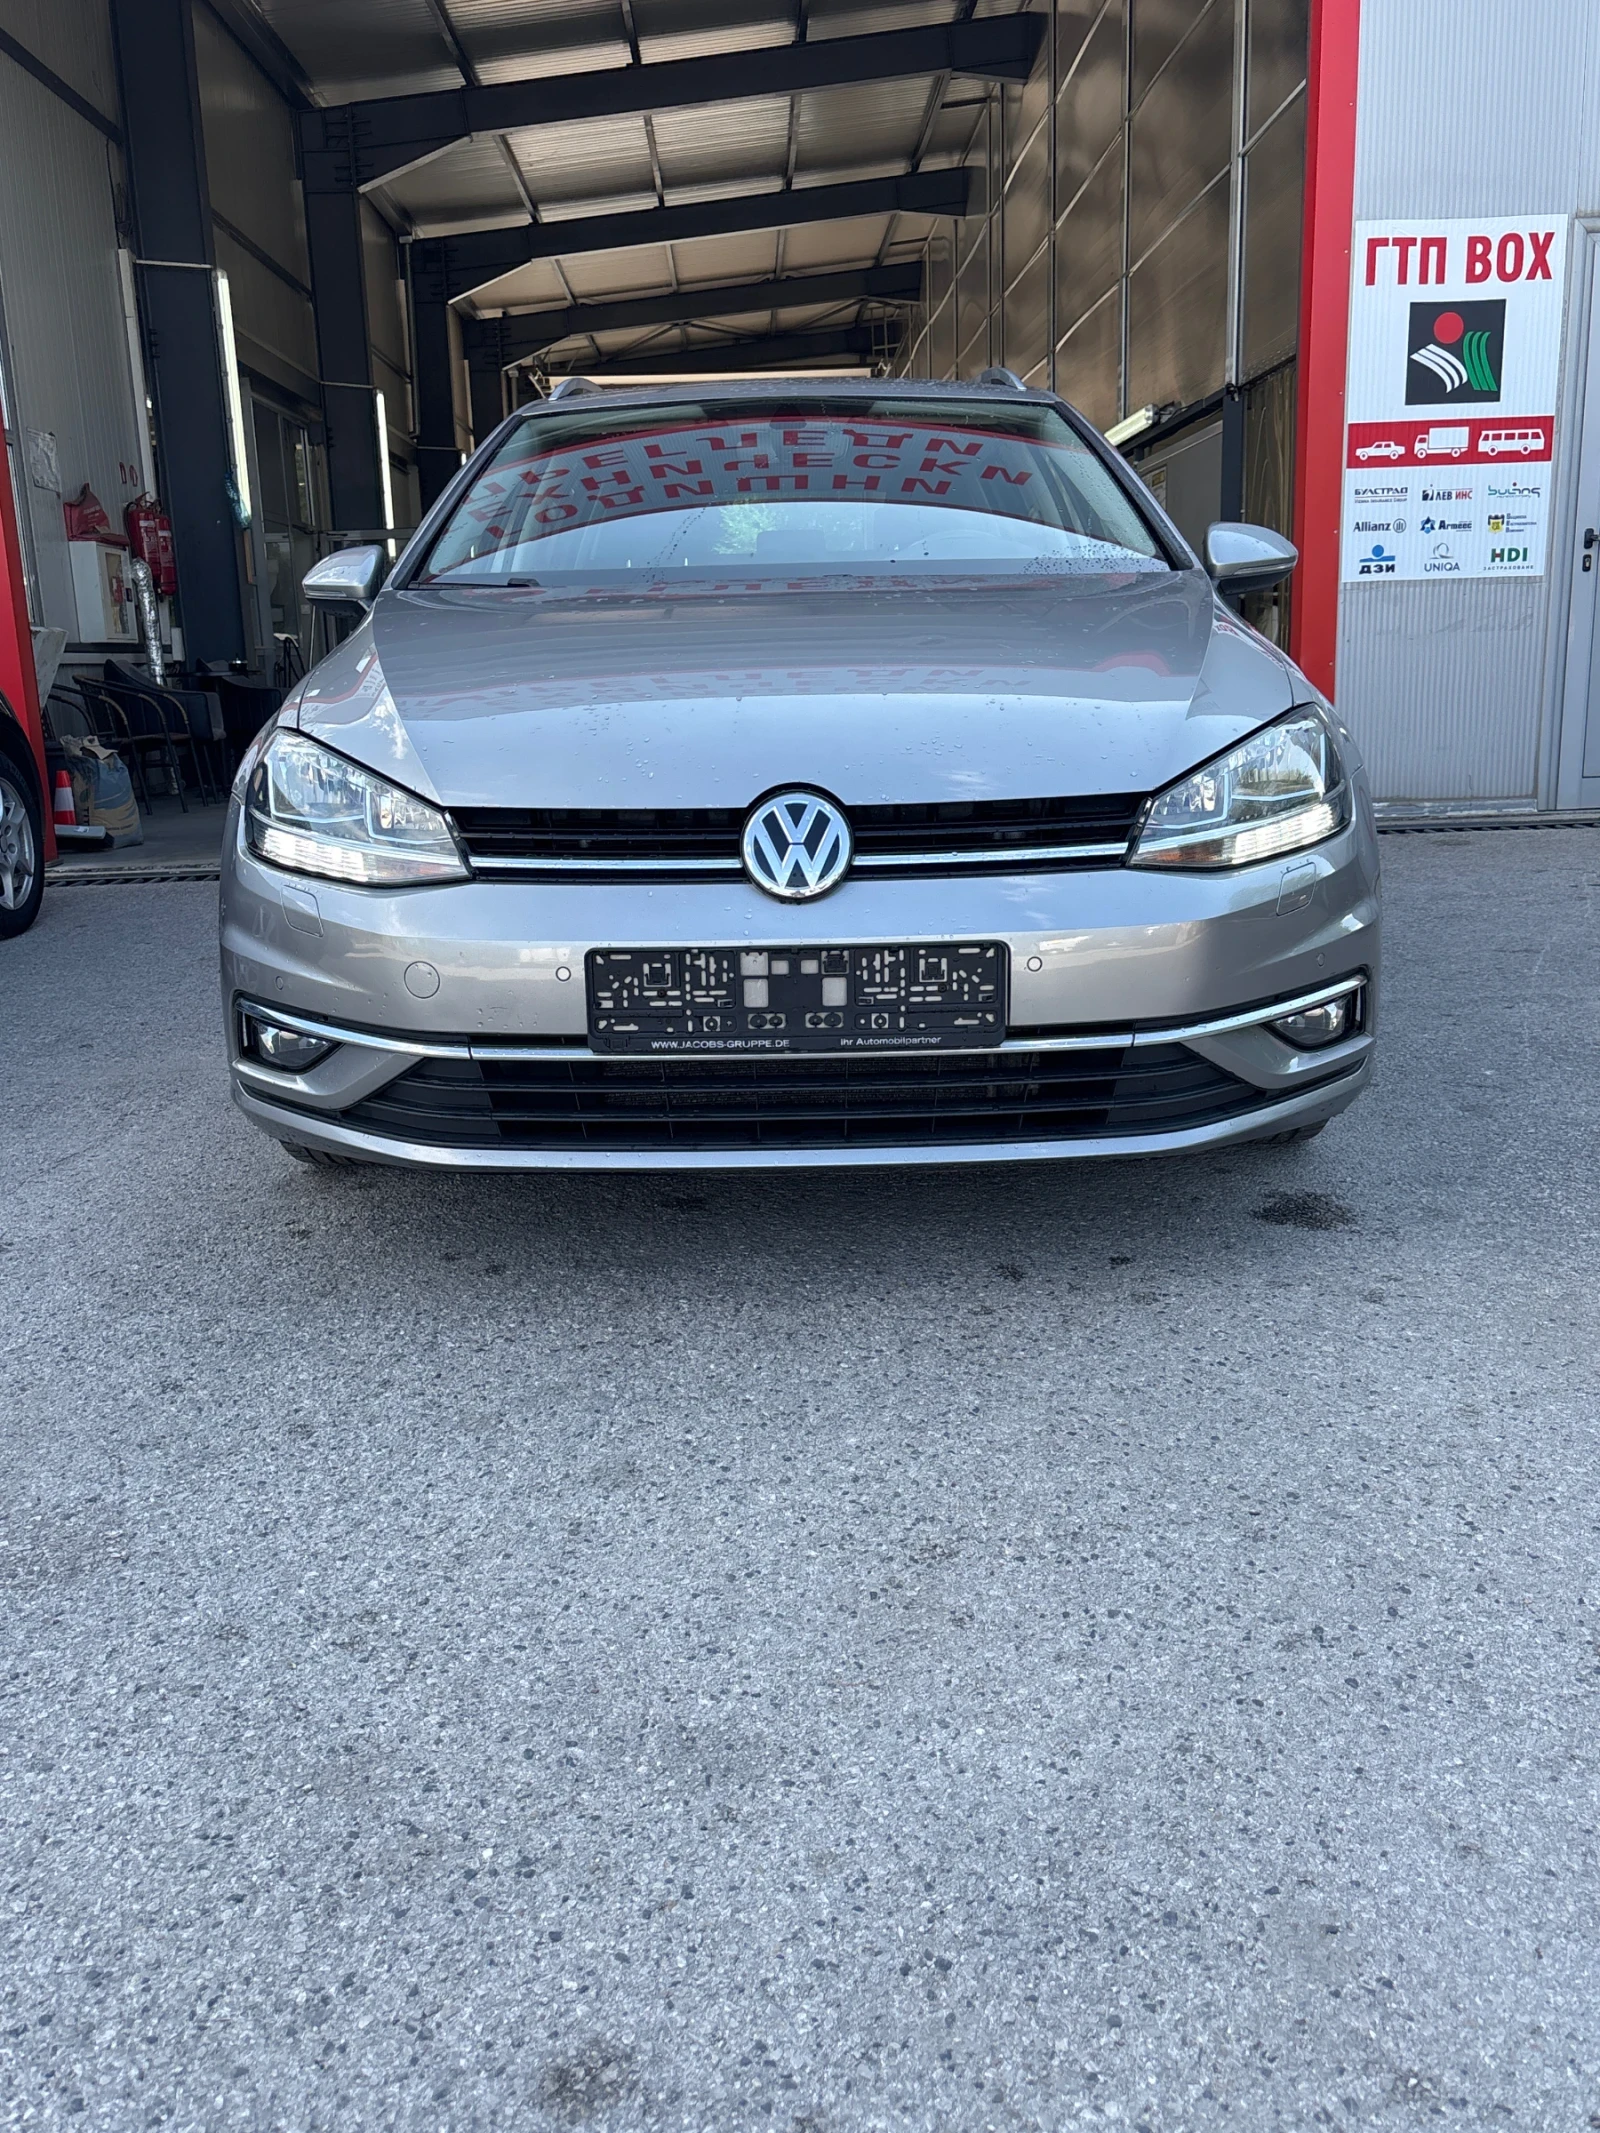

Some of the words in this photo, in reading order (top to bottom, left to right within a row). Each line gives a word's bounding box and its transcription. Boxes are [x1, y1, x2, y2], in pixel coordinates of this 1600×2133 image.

[1365, 236, 1447, 286] ГТП
[1465, 231, 1555, 284] BOX
[1435, 490, 1453, 501] ЛЕВ
[1455, 489, 1473, 500] ИНС
[1353, 521, 1391, 532] Allianz
[1490, 547, 1529, 563] HDI
[1359, 564, 1395, 575] ДЗИ
[1424, 562, 1460, 572] UNIQA
[651, 1039, 790, 1049] WWW.JACOBS-GRUPPE.DE
[856, 1036, 942, 1046] Automobilpartner
